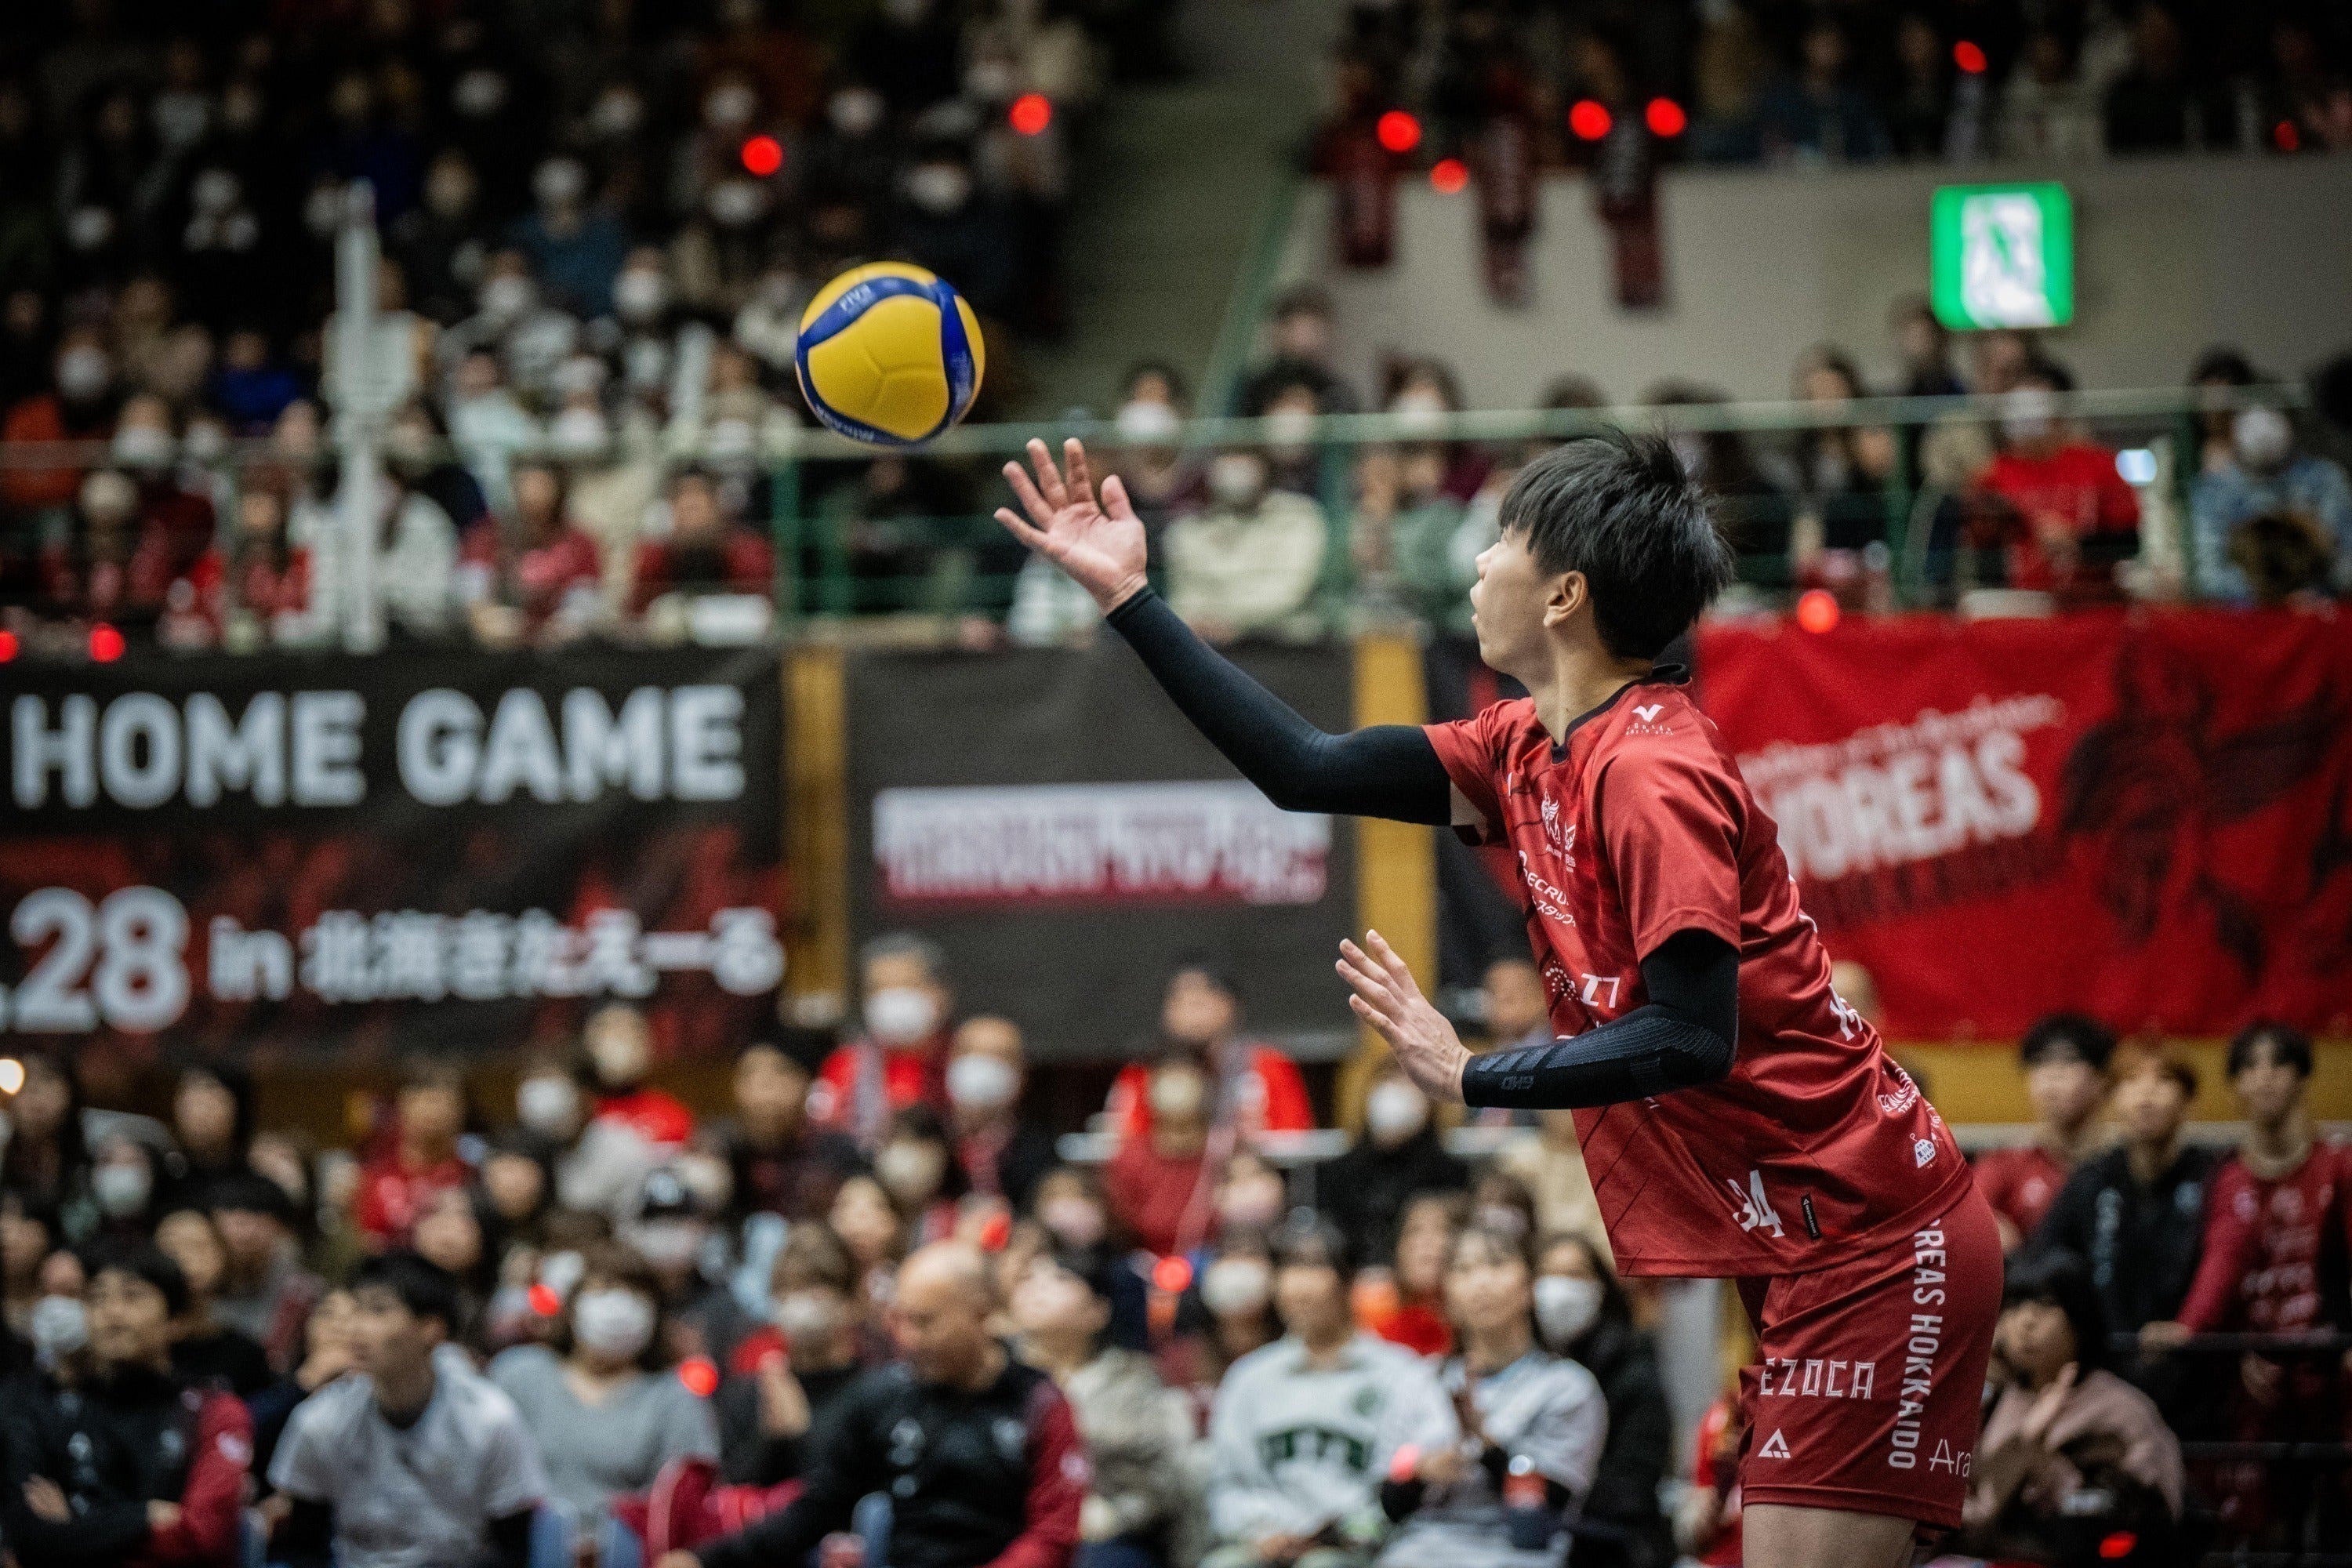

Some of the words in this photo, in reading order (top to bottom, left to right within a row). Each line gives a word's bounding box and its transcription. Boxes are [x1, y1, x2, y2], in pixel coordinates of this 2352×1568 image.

[12, 689, 366, 809] HOME
[396, 684, 747, 805] GAME
[1523, 868, 1569, 906] ECRU
[0, 885, 192, 1034] 28
[207, 914, 292, 1003] in
[1726, 1169, 1785, 1237] 34
[1912, 1218, 1946, 1306] REAS
[1759, 1357, 1876, 1400] EZOCA
[1888, 1314, 1943, 1469] HOKKAIDO
